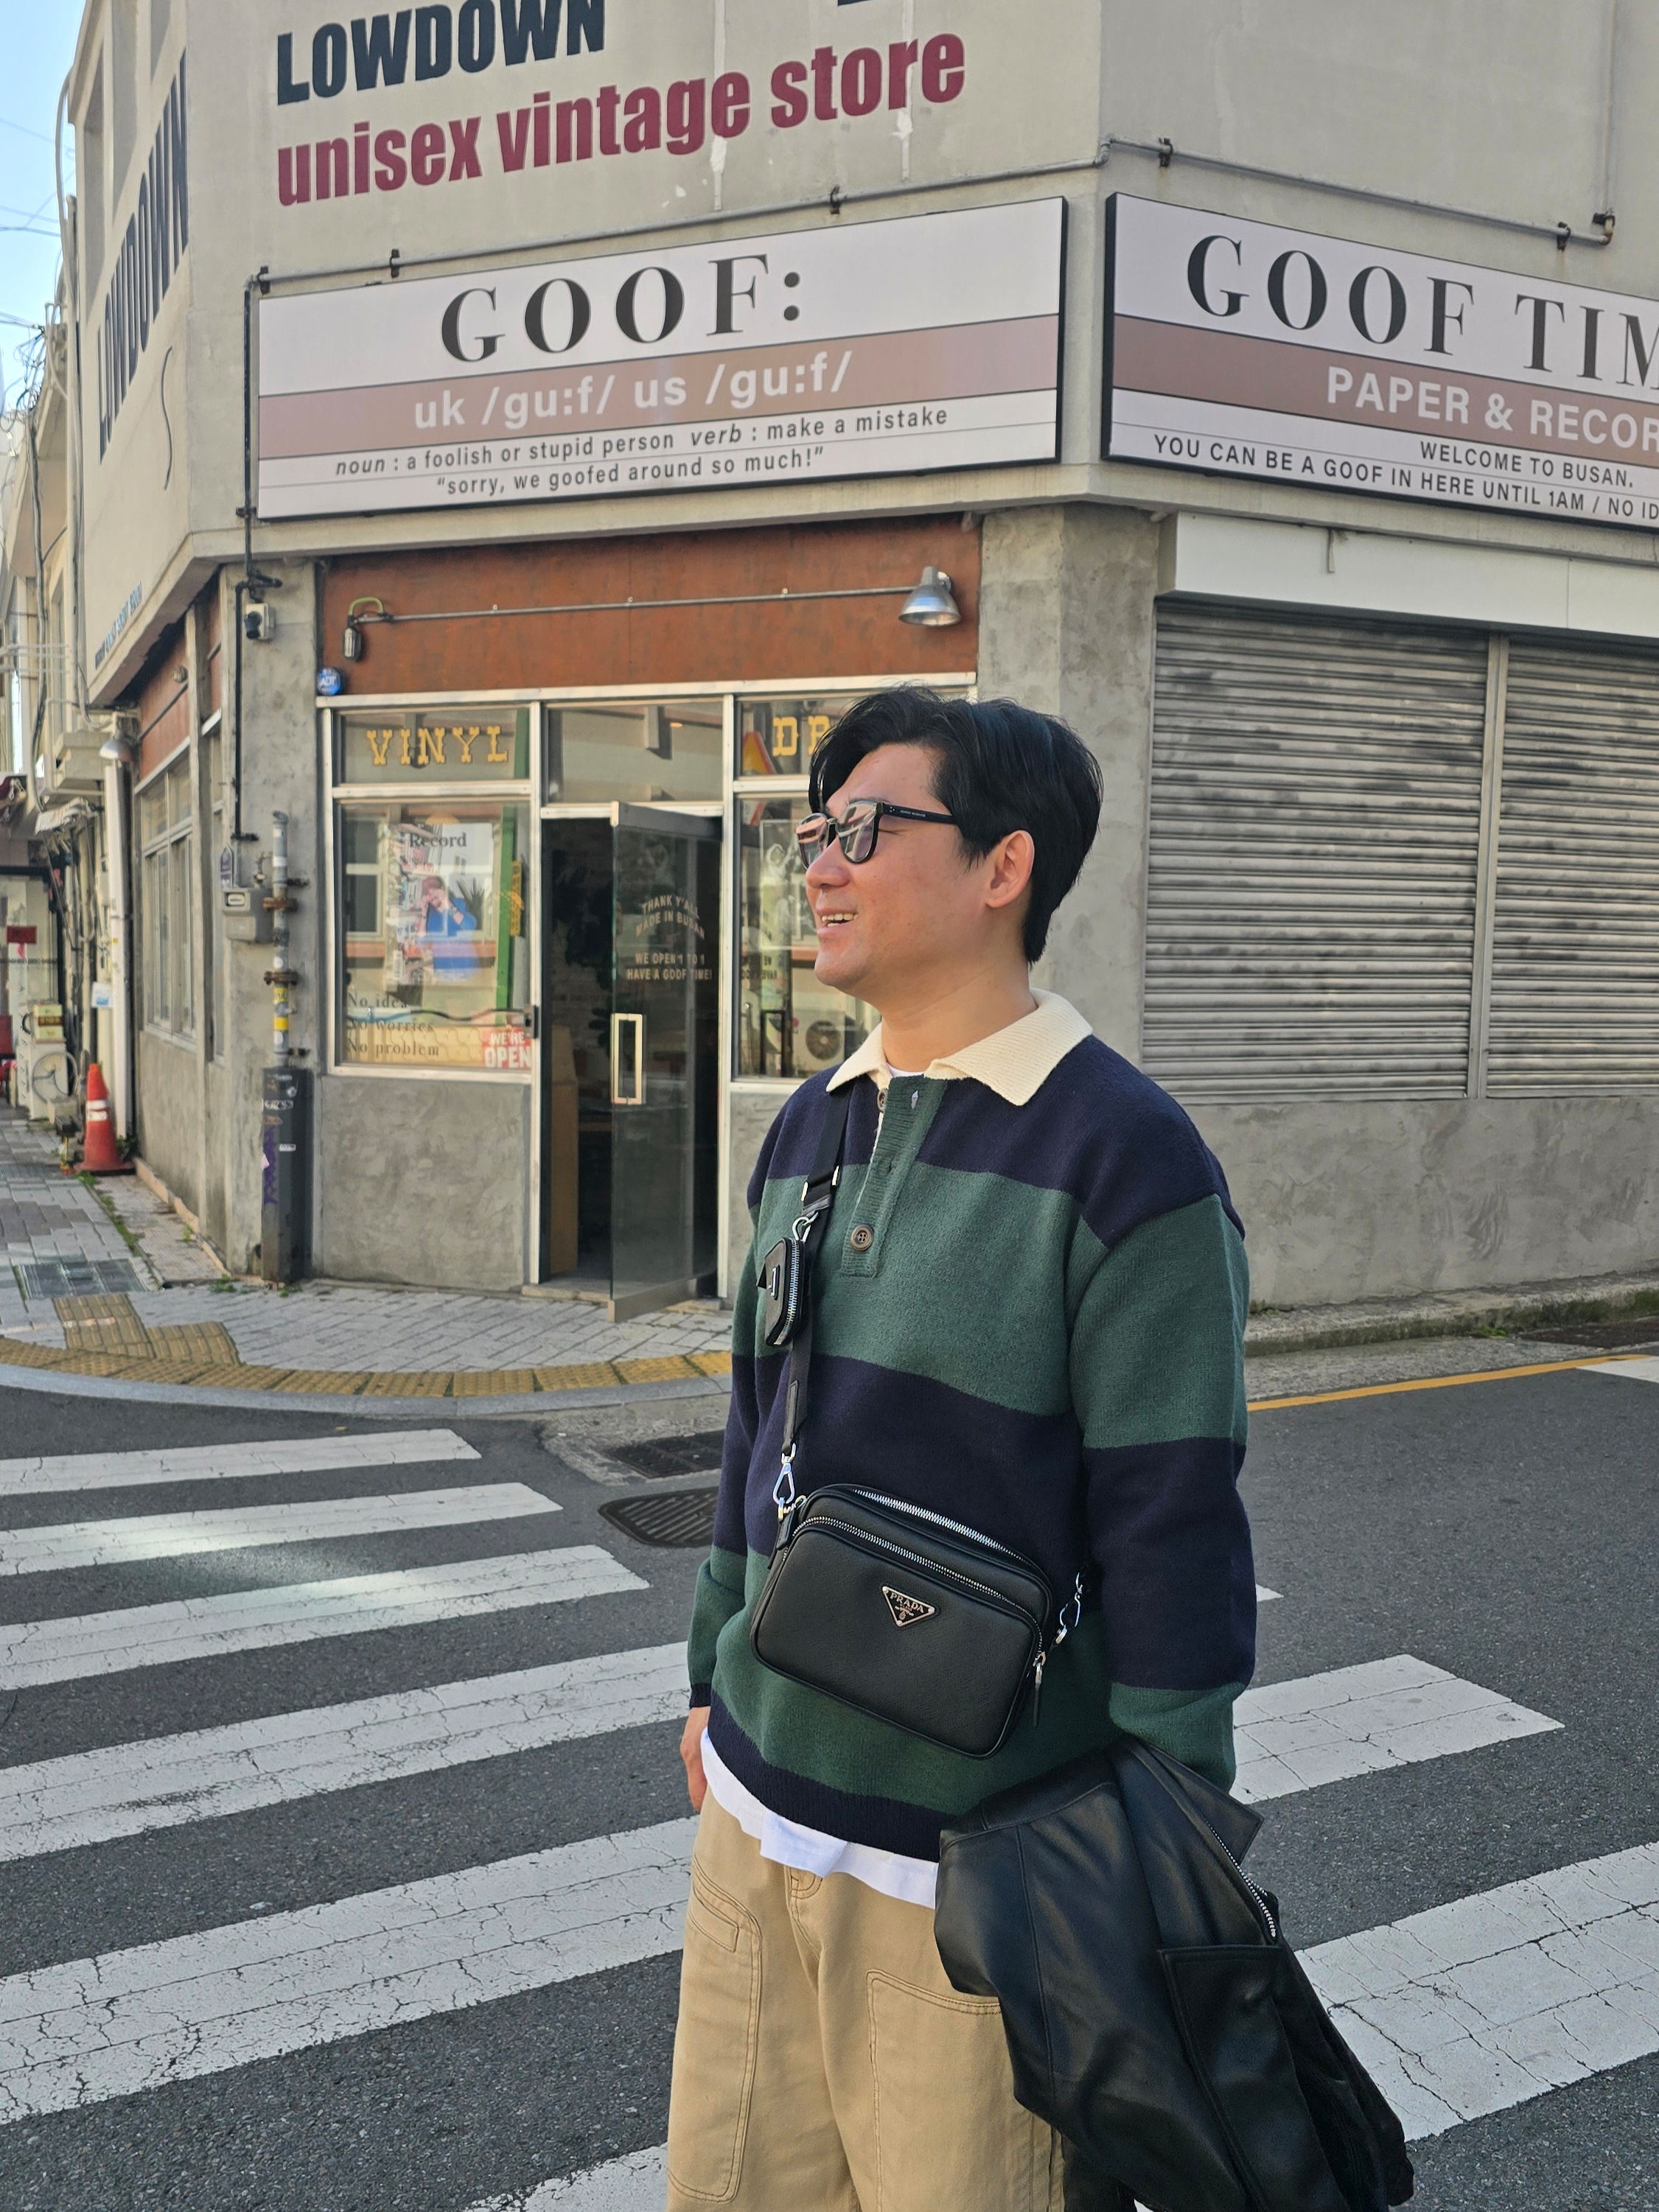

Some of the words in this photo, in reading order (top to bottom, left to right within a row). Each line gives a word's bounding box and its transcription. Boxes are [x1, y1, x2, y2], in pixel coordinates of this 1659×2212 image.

[277, 0, 605, 105] LOWDOWN
[278, 116, 483, 206] unisex
[496, 71, 750, 173] vintage
[770, 33, 965, 128] store
[97, 46, 189, 465] LOWDOWN
[441, 253, 802, 363] GOOF:
[1187, 234, 1474, 356] GOOF
[414, 390, 466, 430] uk
[481, 375, 615, 430] /gu:f/
[634, 376, 687, 409] us
[705, 350, 853, 410] /gu:f/
[1327, 365, 1470, 425] PAPER
[1484, 393, 1514, 432] &
[335, 456, 386, 476] noun
[393, 457, 399, 472] :
[407, 455, 416, 470] a
[425, 446, 492, 469] foolish
[501, 446, 522, 463] or
[529, 436, 594, 461] stupid
[603, 432, 674, 457] person
[691, 423, 743, 447] verb
[752, 427, 758, 441] :
[767, 417, 825, 441] make
[834, 419, 845, 433] a
[856, 406, 948, 432] mistake
[514, 475, 540, 490] we
[549, 463, 619, 492] goofed
[629, 456, 702, 480] around
[712, 457, 735, 475] so
[1154, 433, 1200, 458] YOU
[1210, 442, 1256, 466] CAN
[1265, 449, 1293, 472] BE
[1301, 455, 1315, 475] A
[1324, 458, 1383, 483] GOOF
[1391, 467, 1411, 488] IN
[1421, 472, 1474, 496] HERE
[1483, 480, 1541, 505] UNTIL
[1549, 491, 1584, 511] 1AM
[1592, 495, 1600, 514] /
[1608, 497, 1634, 517] NO
[1421, 441, 1522, 472] WELCOME
[1530, 457, 1554, 477] TO
[1563, 462, 1634, 489] BUSAN.
[366, 725, 508, 765] VINYL
[409, 832, 468, 848] Record
[636, 911, 661, 937] MADE
[664, 910, 674, 923] IN
[677, 911, 705, 940] BUSAN
[642, 895, 673, 914] THANK
[675, 895, 700, 920] Y'ALL
[626, 967, 651, 980] HAVE
[654, 967, 660, 980] A
[663, 967, 687, 980] GOOF
[635, 952, 649, 965] WE
[652, 952, 676, 965] OPEN
[686, 953, 698, 965] TO
[348, 992, 368, 1007] No
[376, 1020, 434, 1032] worries
[489, 1031, 525, 1045] WE'RE
[347, 1038, 368, 1053] No
[376, 1040, 440, 1058] problem
[484, 1046, 532, 1068] OPEN
[890, 1592, 924, 1614] PRADA
